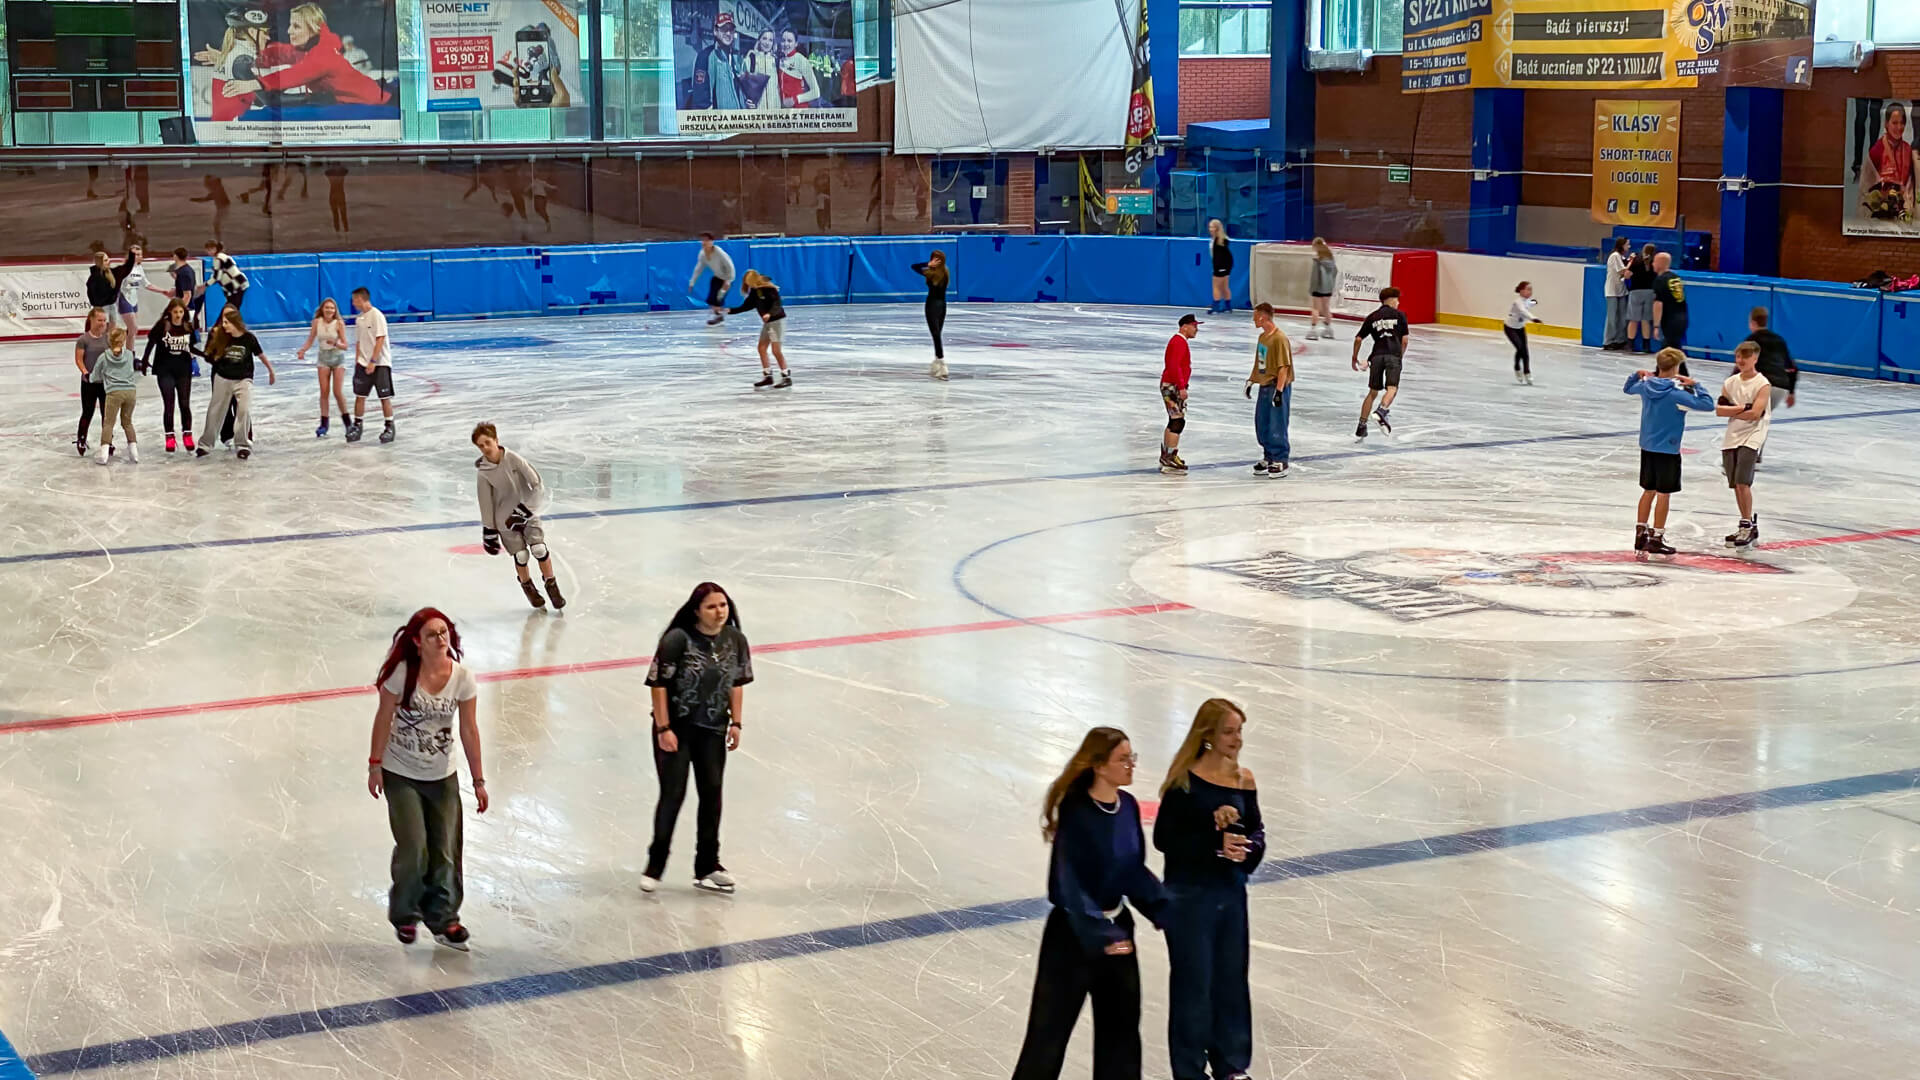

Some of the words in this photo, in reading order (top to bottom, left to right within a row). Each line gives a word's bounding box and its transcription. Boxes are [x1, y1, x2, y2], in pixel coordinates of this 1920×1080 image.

[426, 3, 490, 14] HOMENET
[1472, 23, 1481, 39] 3
[1546, 19, 1570, 36] Bądź
[1576, 17, 1629, 36] pierwszy!
[444, 52, 475, 66] 19,90
[478, 52, 488, 64] zł
[1516, 59, 1538, 76] Bądź
[1542, 60, 1583, 75] uczniem
[1617, 60, 1621, 75] i
[687, 114, 728, 122] PATRYCJA
[731, 113, 790, 121] MALISZEWSKA
[1612, 114, 1660, 132] KLASY
[680, 122, 717, 131] URSZULĄ
[822, 121, 852, 129] CROSEM
[1600, 149, 1672, 162] SHORT-TRACK
[1617, 168, 1659, 184] OGÓLNE
[21, 290, 81, 300] Ministerstwo
[21, 302, 51, 312] Sportu
